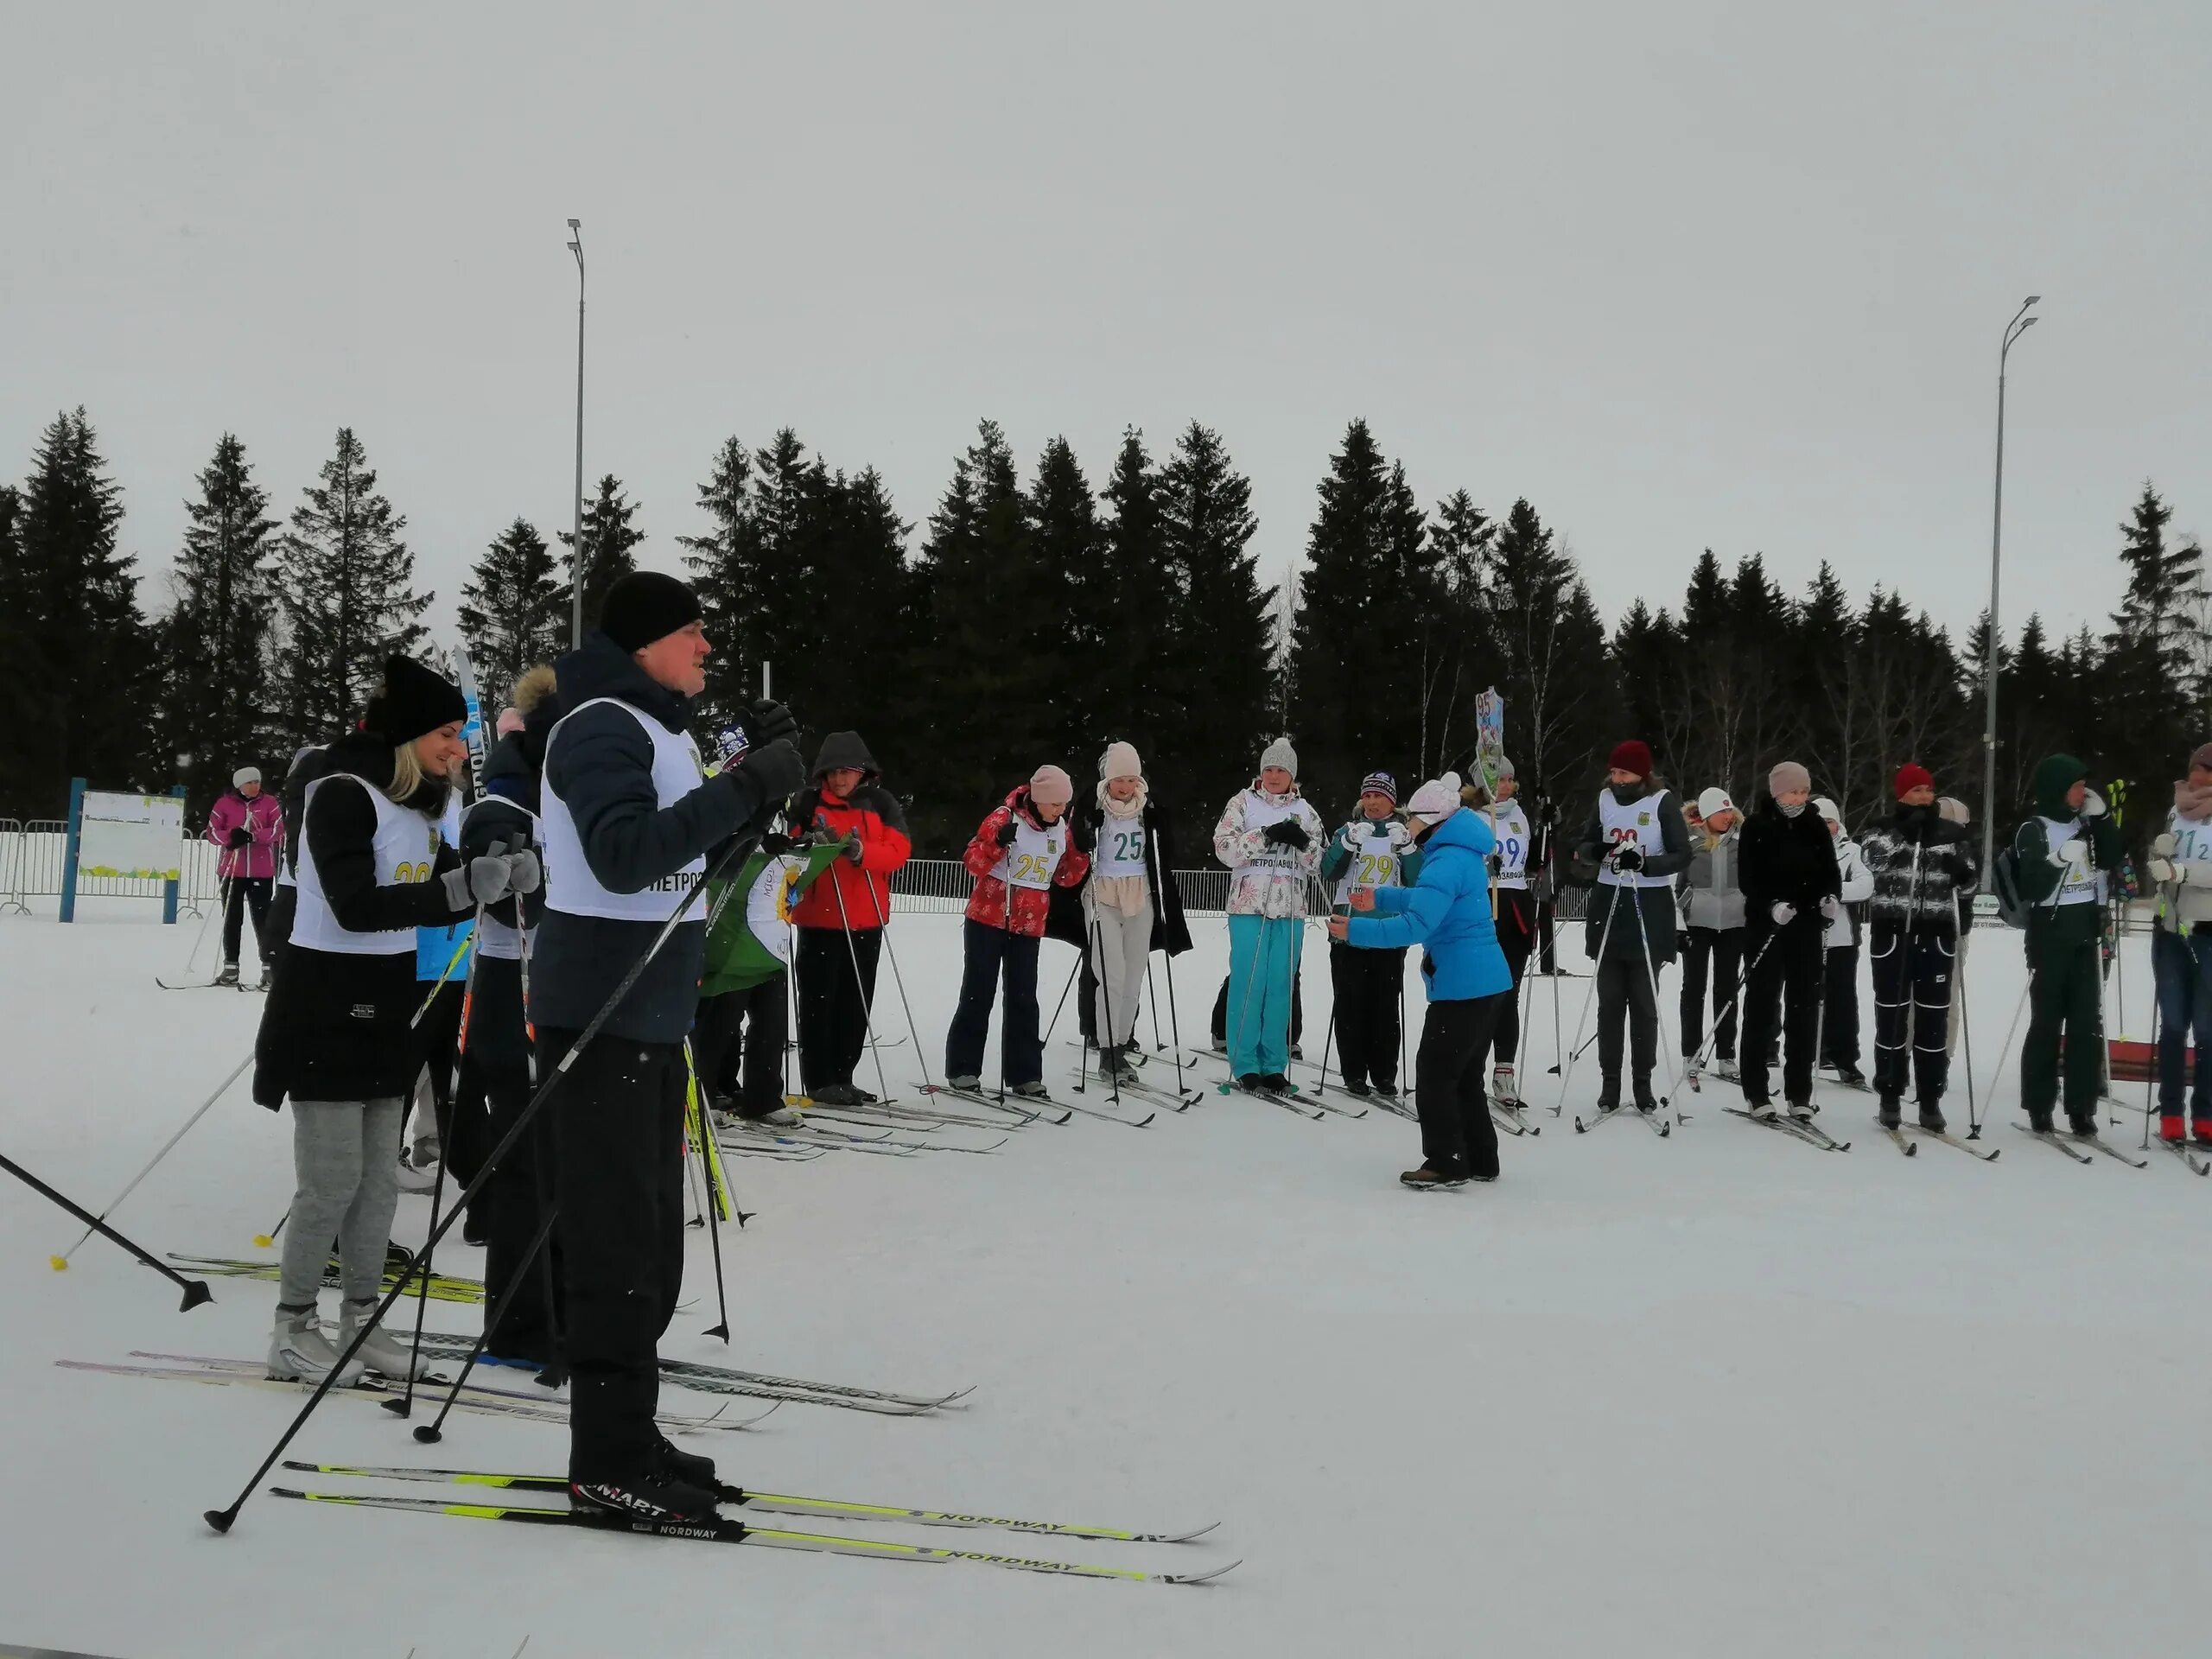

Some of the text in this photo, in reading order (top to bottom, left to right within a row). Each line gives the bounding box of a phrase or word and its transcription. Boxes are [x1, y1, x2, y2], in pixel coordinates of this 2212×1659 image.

[1114, 831, 1141, 861] 25
[2198, 843, 2209, 860] 2
[1014, 854, 1049, 883] 25
[1358, 855, 1394, 884] 29
[659, 1525, 718, 1540] NORDWAY
[938, 1514, 1067, 1531] NORDWAY
[945, 1551, 1079, 1571] NORDWAY
